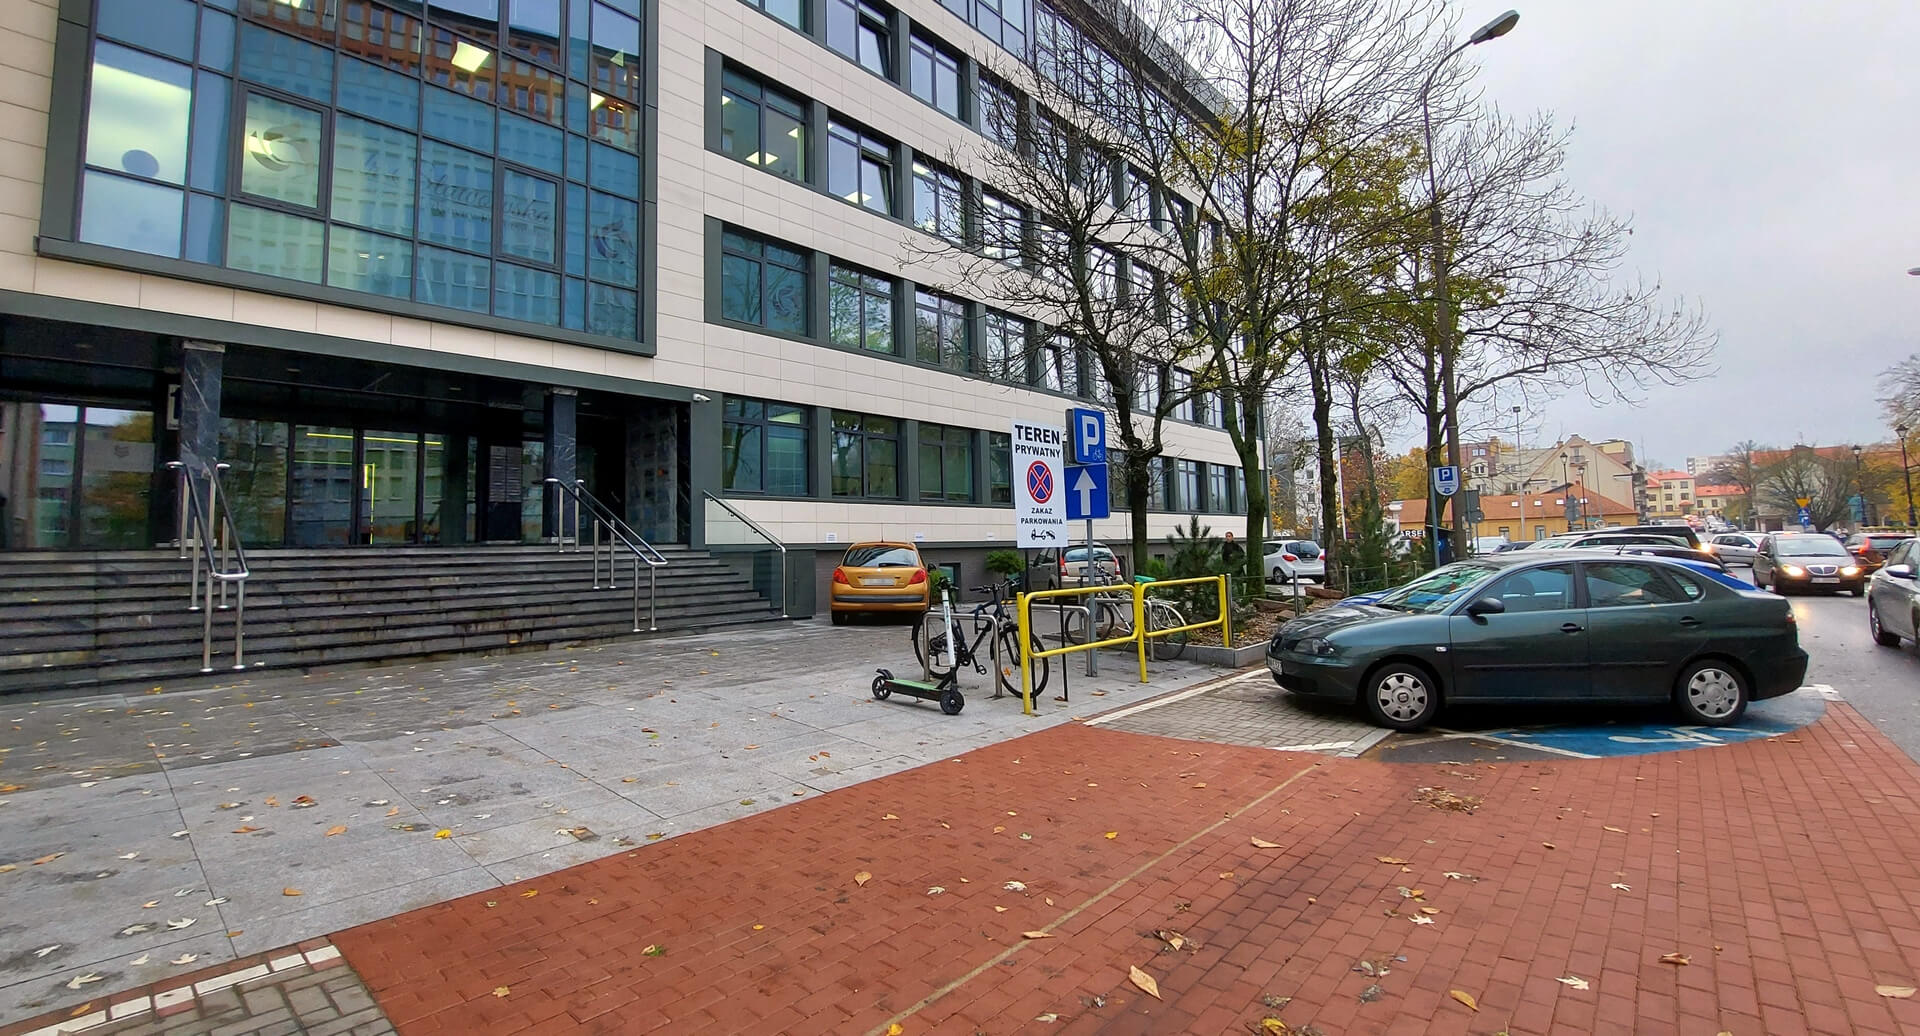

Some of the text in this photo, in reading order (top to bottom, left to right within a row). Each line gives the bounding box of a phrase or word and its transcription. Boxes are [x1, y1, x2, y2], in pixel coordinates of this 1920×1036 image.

[1014, 425, 1060, 445] TEREN
[1081, 415, 1100, 456] P
[1015, 444, 1061, 458] PRYWATNY
[1441, 469, 1450, 480] P
[1031, 507, 1053, 515] ZAKAZ
[1020, 517, 1063, 525] PARKOWANIA
